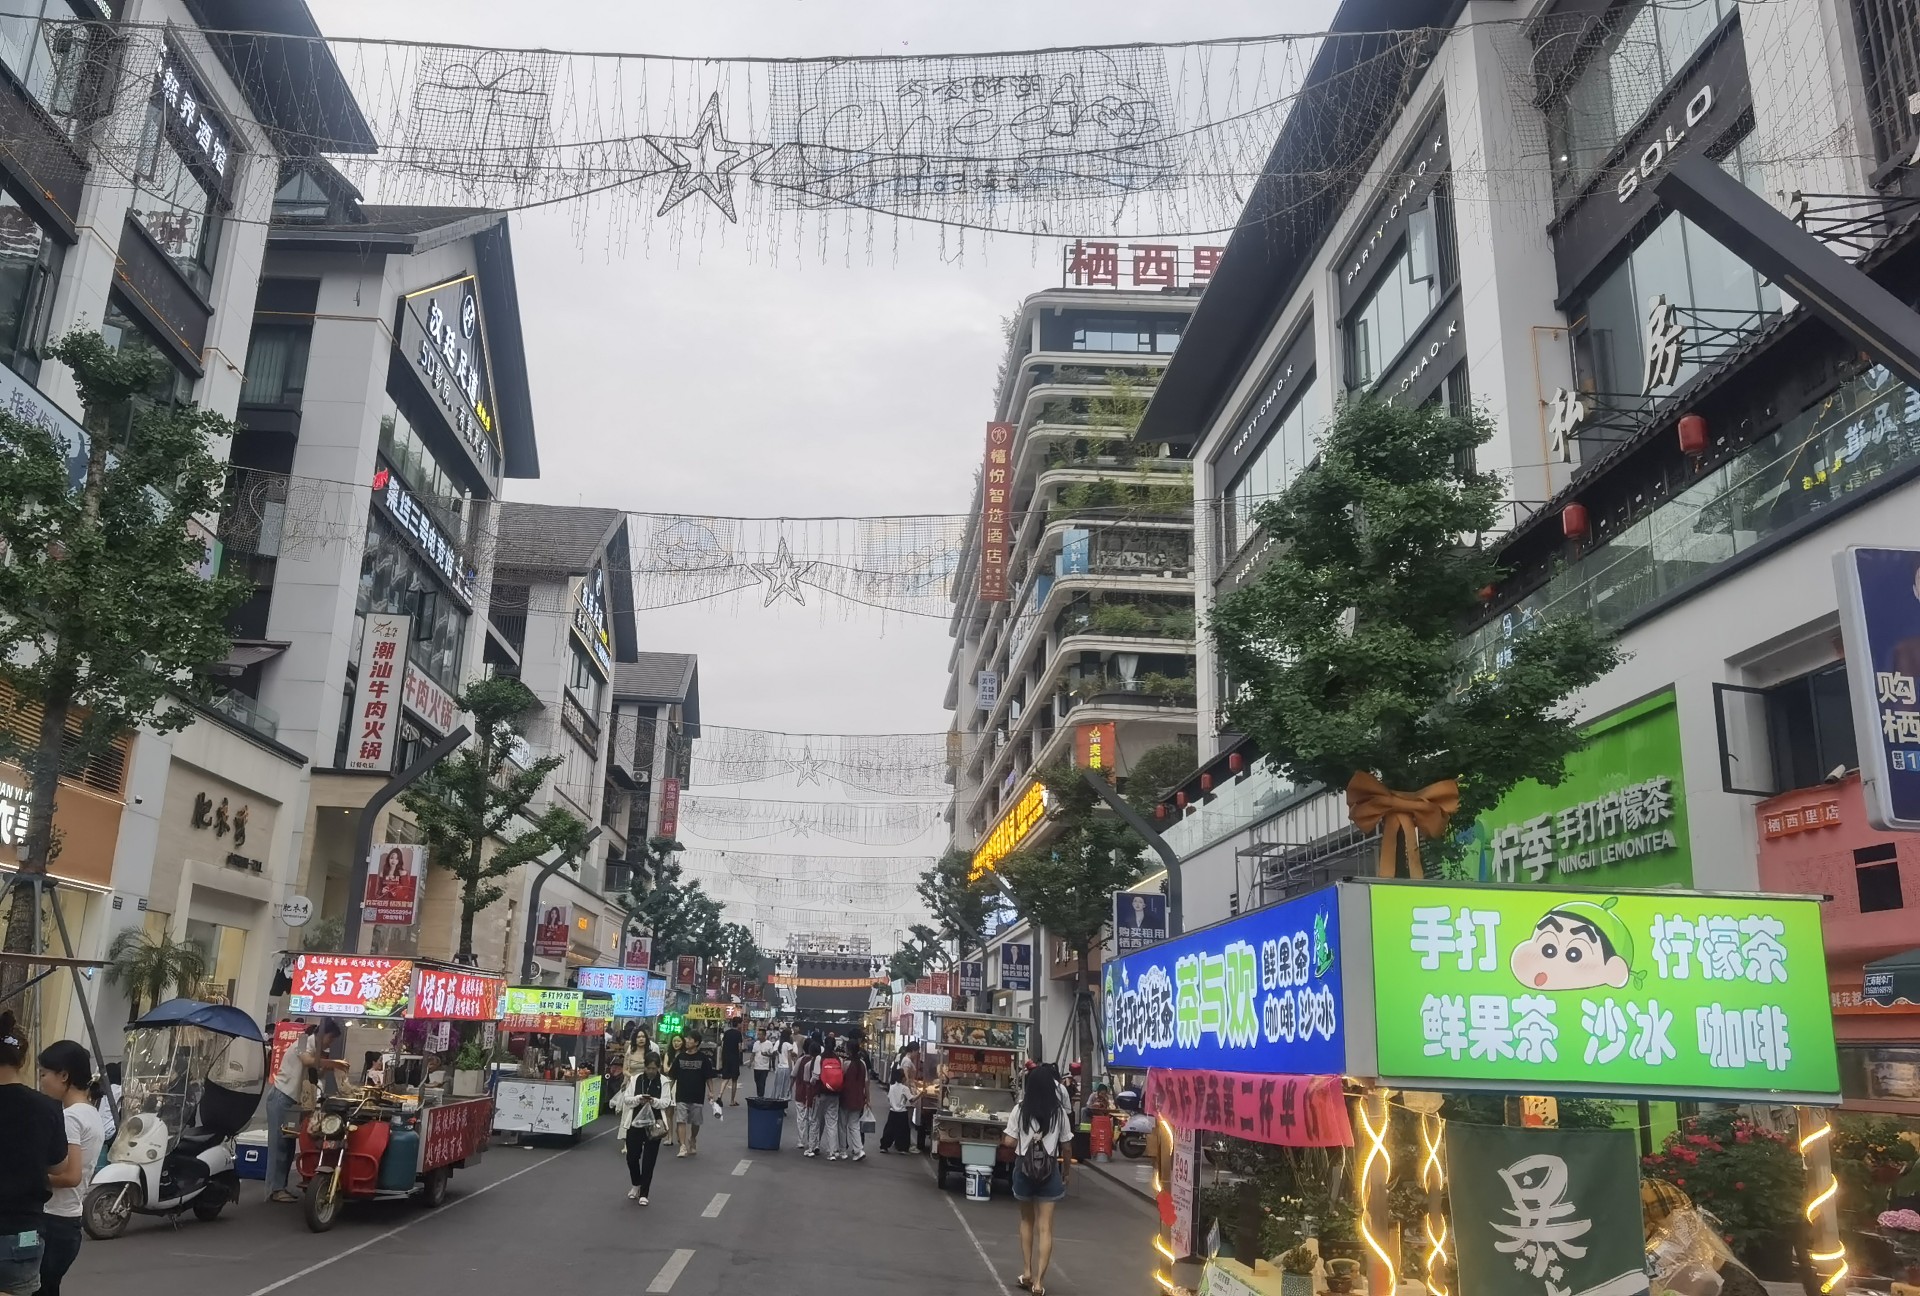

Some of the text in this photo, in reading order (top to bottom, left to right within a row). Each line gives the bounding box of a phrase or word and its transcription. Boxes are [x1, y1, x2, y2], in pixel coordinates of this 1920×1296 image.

[1618, 84, 1713, 203] SOLO
[359, 641, 397, 761] 潮汕牛肉火锅
[405, 666, 453, 734] 牛肉火锅
[1490, 777, 1676, 883] 柠季 手打柠檬茶
[1558, 830, 1677, 876] NINGJI LEMONTEA
[1766, 804, 1840, 835] 栖西里店
[1118, 927, 1165, 939] 购买租用
[1262, 930, 1309, 991] 鲜果茶
[1410, 905, 1789, 985] 手打 柠檬茶
[300, 969, 383, 999] 烤面筋
[420, 973, 458, 1016] 烤面筋
[1115, 975, 1175, 1055] 手打柠檬茶
[1176, 940, 1259, 1050] 茶与欢
[1263, 984, 1336, 1043] 咖啡 沙冰
[1420, 993, 1794, 1072] 鲜果茶 沙冰 咖啡
